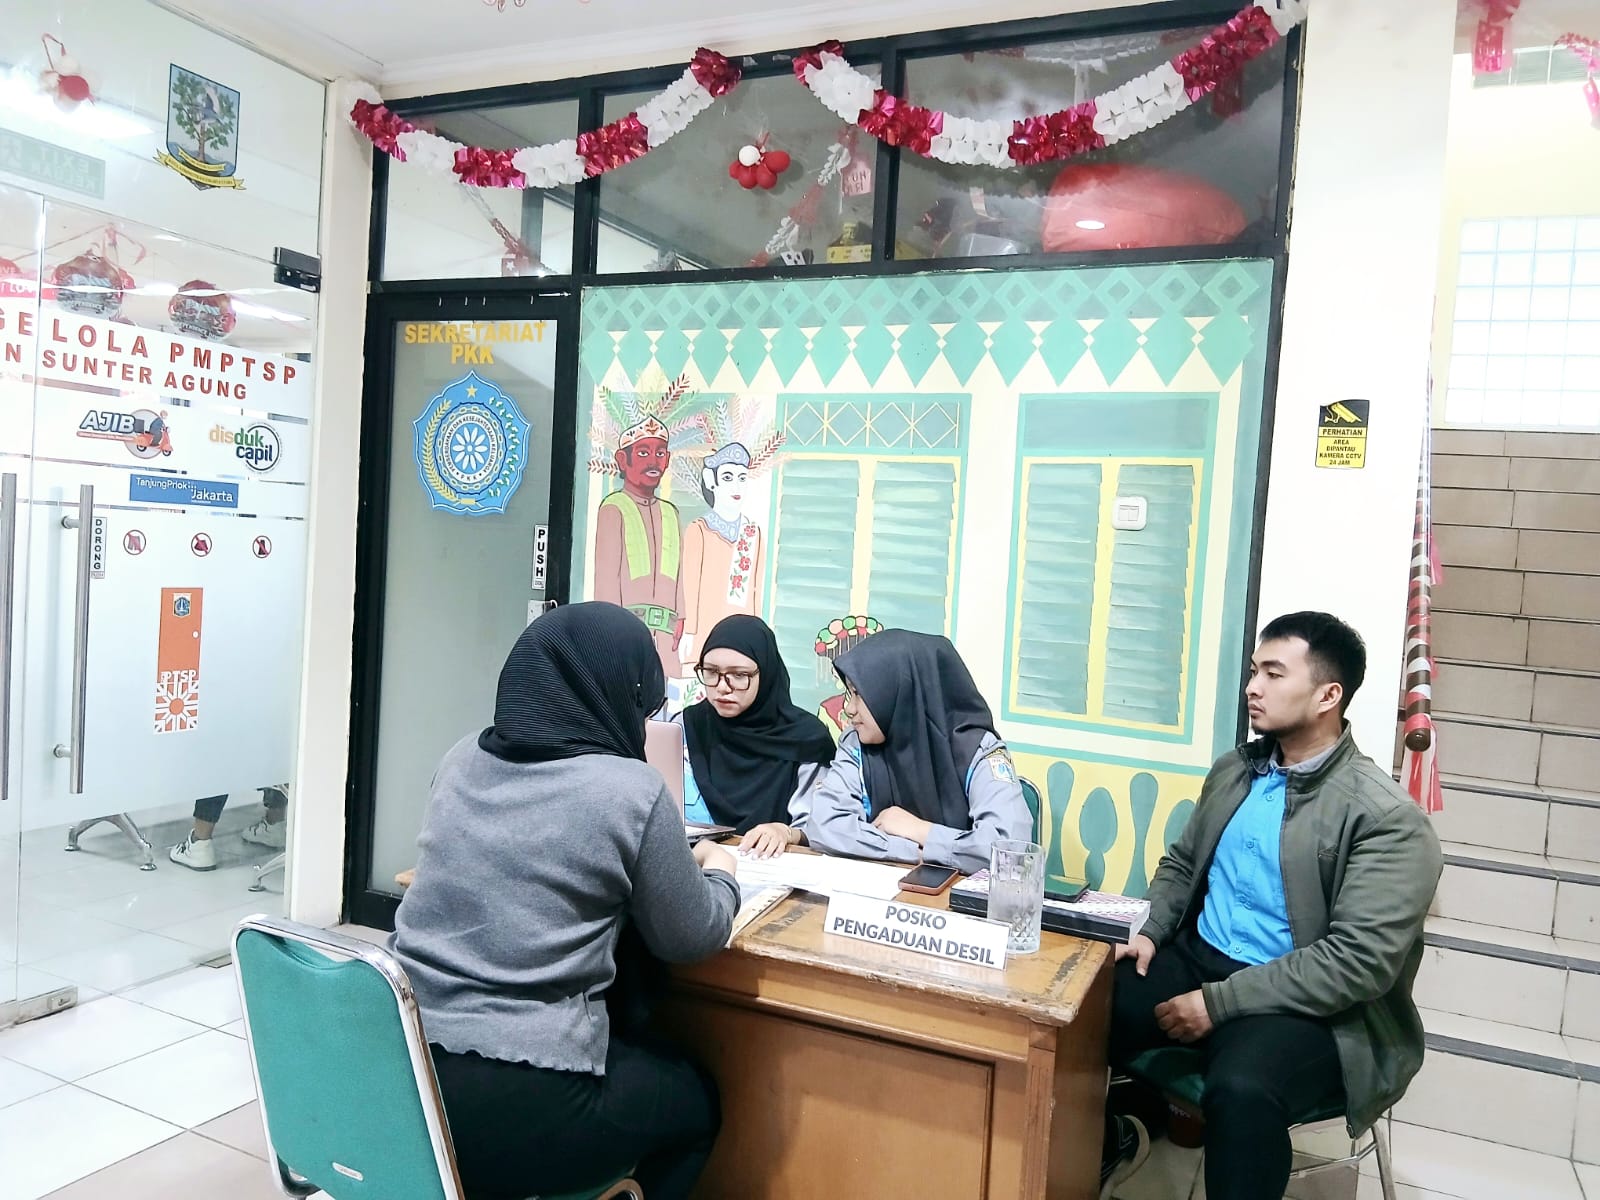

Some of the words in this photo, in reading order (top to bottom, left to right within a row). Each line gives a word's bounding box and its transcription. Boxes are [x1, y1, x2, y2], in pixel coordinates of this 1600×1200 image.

[404, 321, 547, 344] SEKRETARIAT
[170, 342, 296, 385] PMPTSP
[451, 343, 494, 365] PKK
[42, 349, 152, 385] SUNTER
[164, 371, 246, 400] AGUNG
[80, 410, 136, 434] AJIB
[1322, 428, 1363, 437] PERHATIAN
[236, 444, 273, 465] capil
[1319, 452, 1344, 460] KAMERA
[93, 518, 103, 570] DORONG
[535, 529, 546, 578] PUSH
[885, 905, 947, 931] POSKO
[833, 917, 942, 954] PENGADUAN
[945, 940, 995, 966] DESIL
